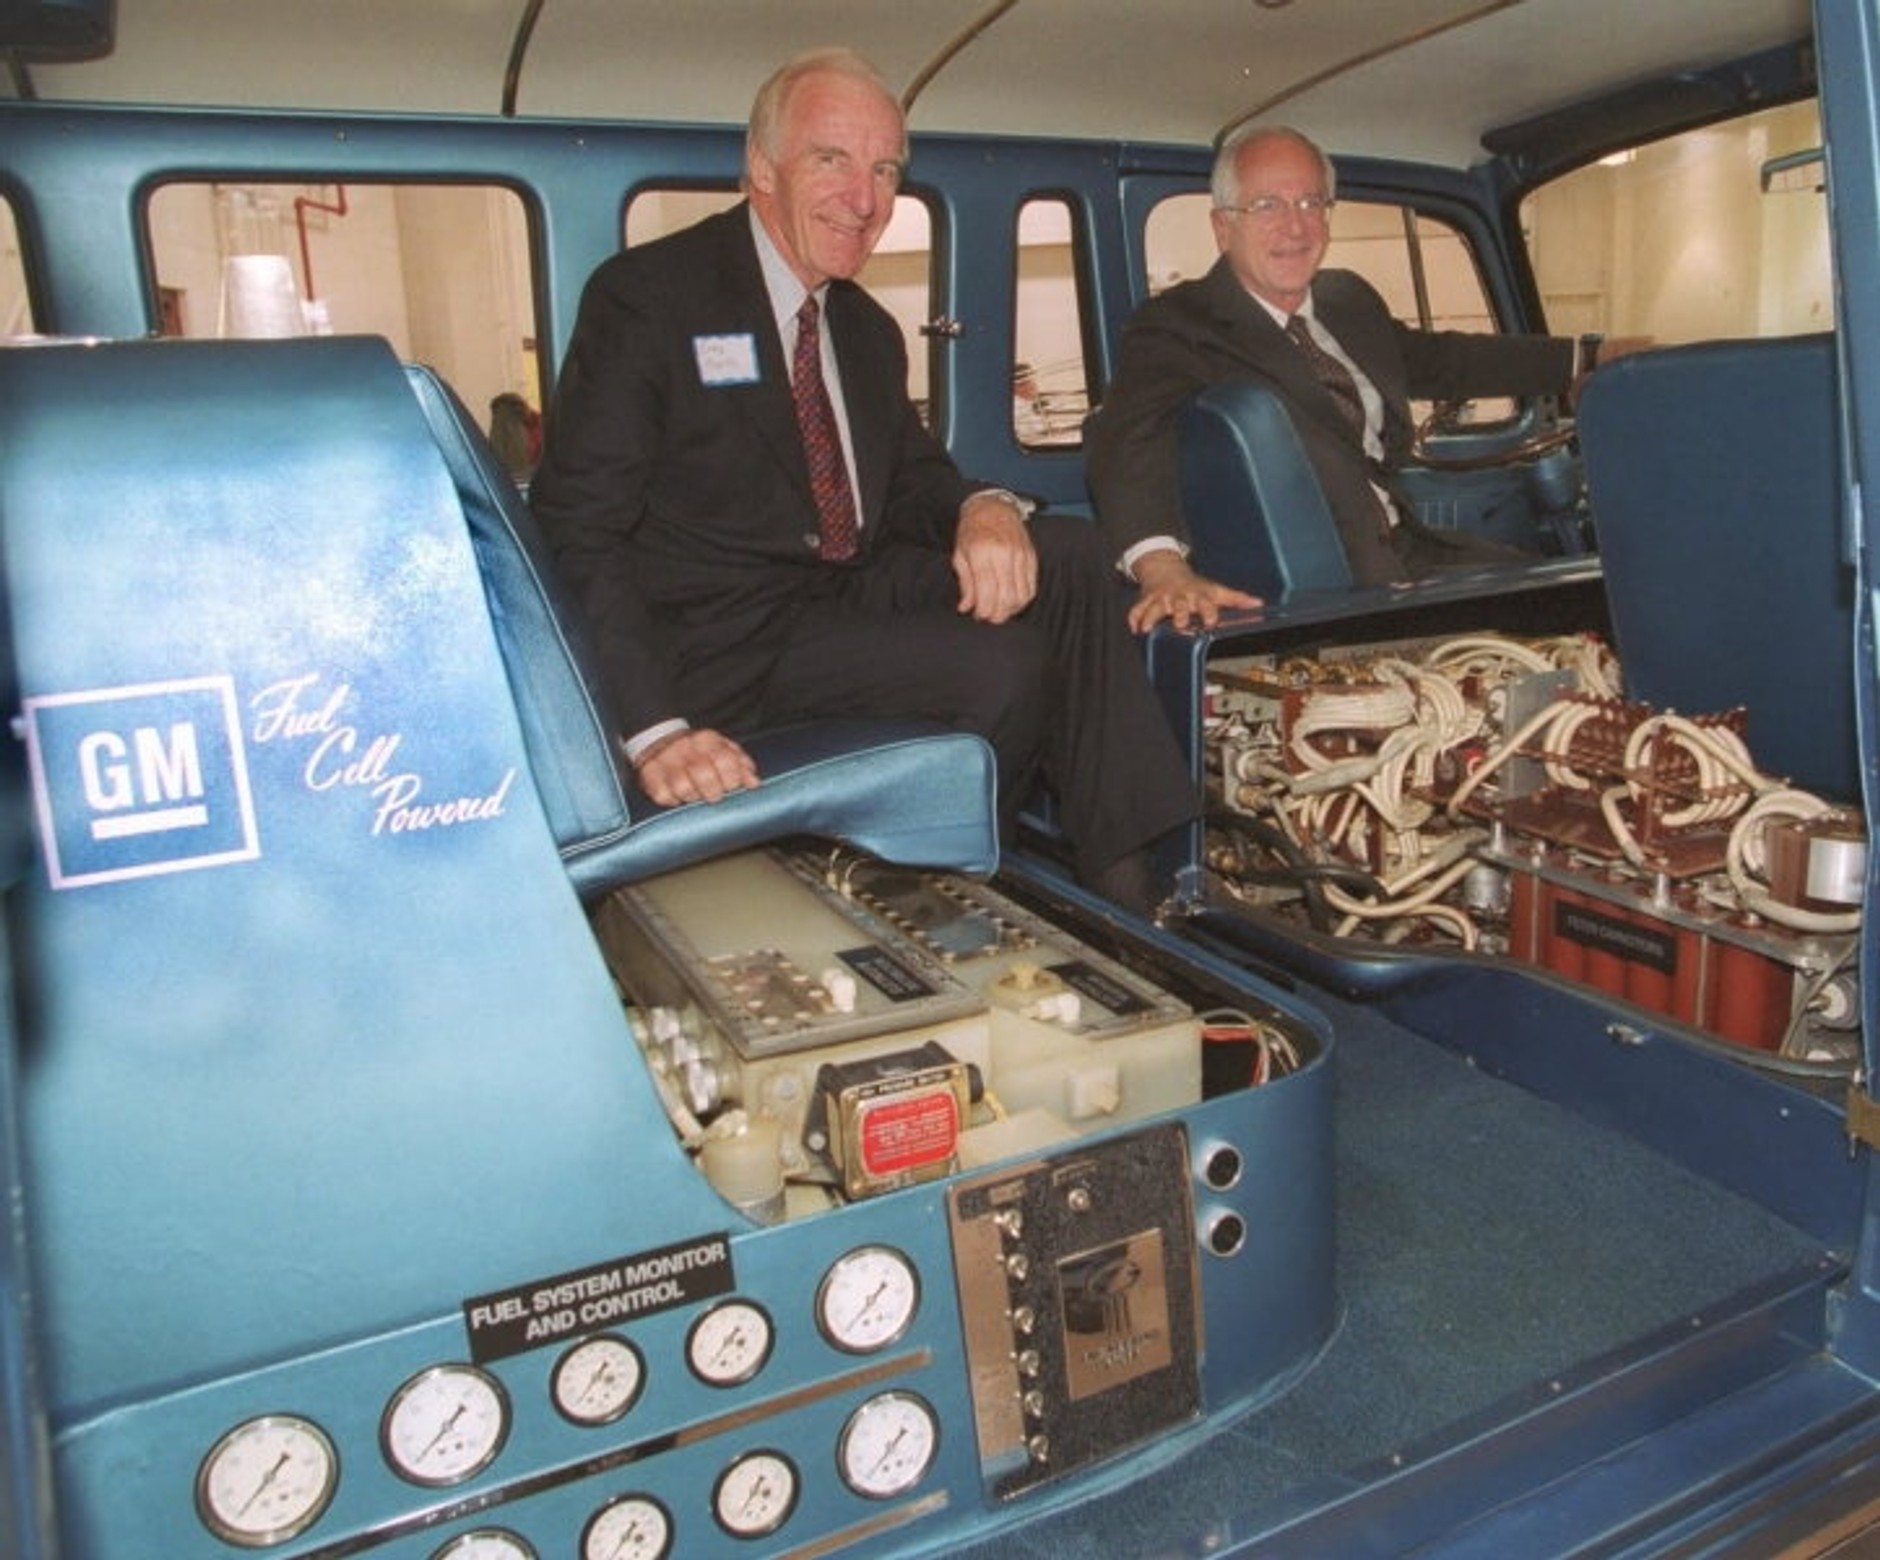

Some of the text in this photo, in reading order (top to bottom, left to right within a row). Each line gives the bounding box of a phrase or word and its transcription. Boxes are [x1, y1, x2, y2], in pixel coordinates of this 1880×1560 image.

[252, 673, 350, 743] Fuel
[81, 722, 204, 811] GM
[305, 727, 400, 790] Cell
[370, 769, 517, 836] Powered
[471, 1242, 726, 1329] FUEL SYSTEM MONITOR
[525, 1280, 684, 1341] AND CONTROL
